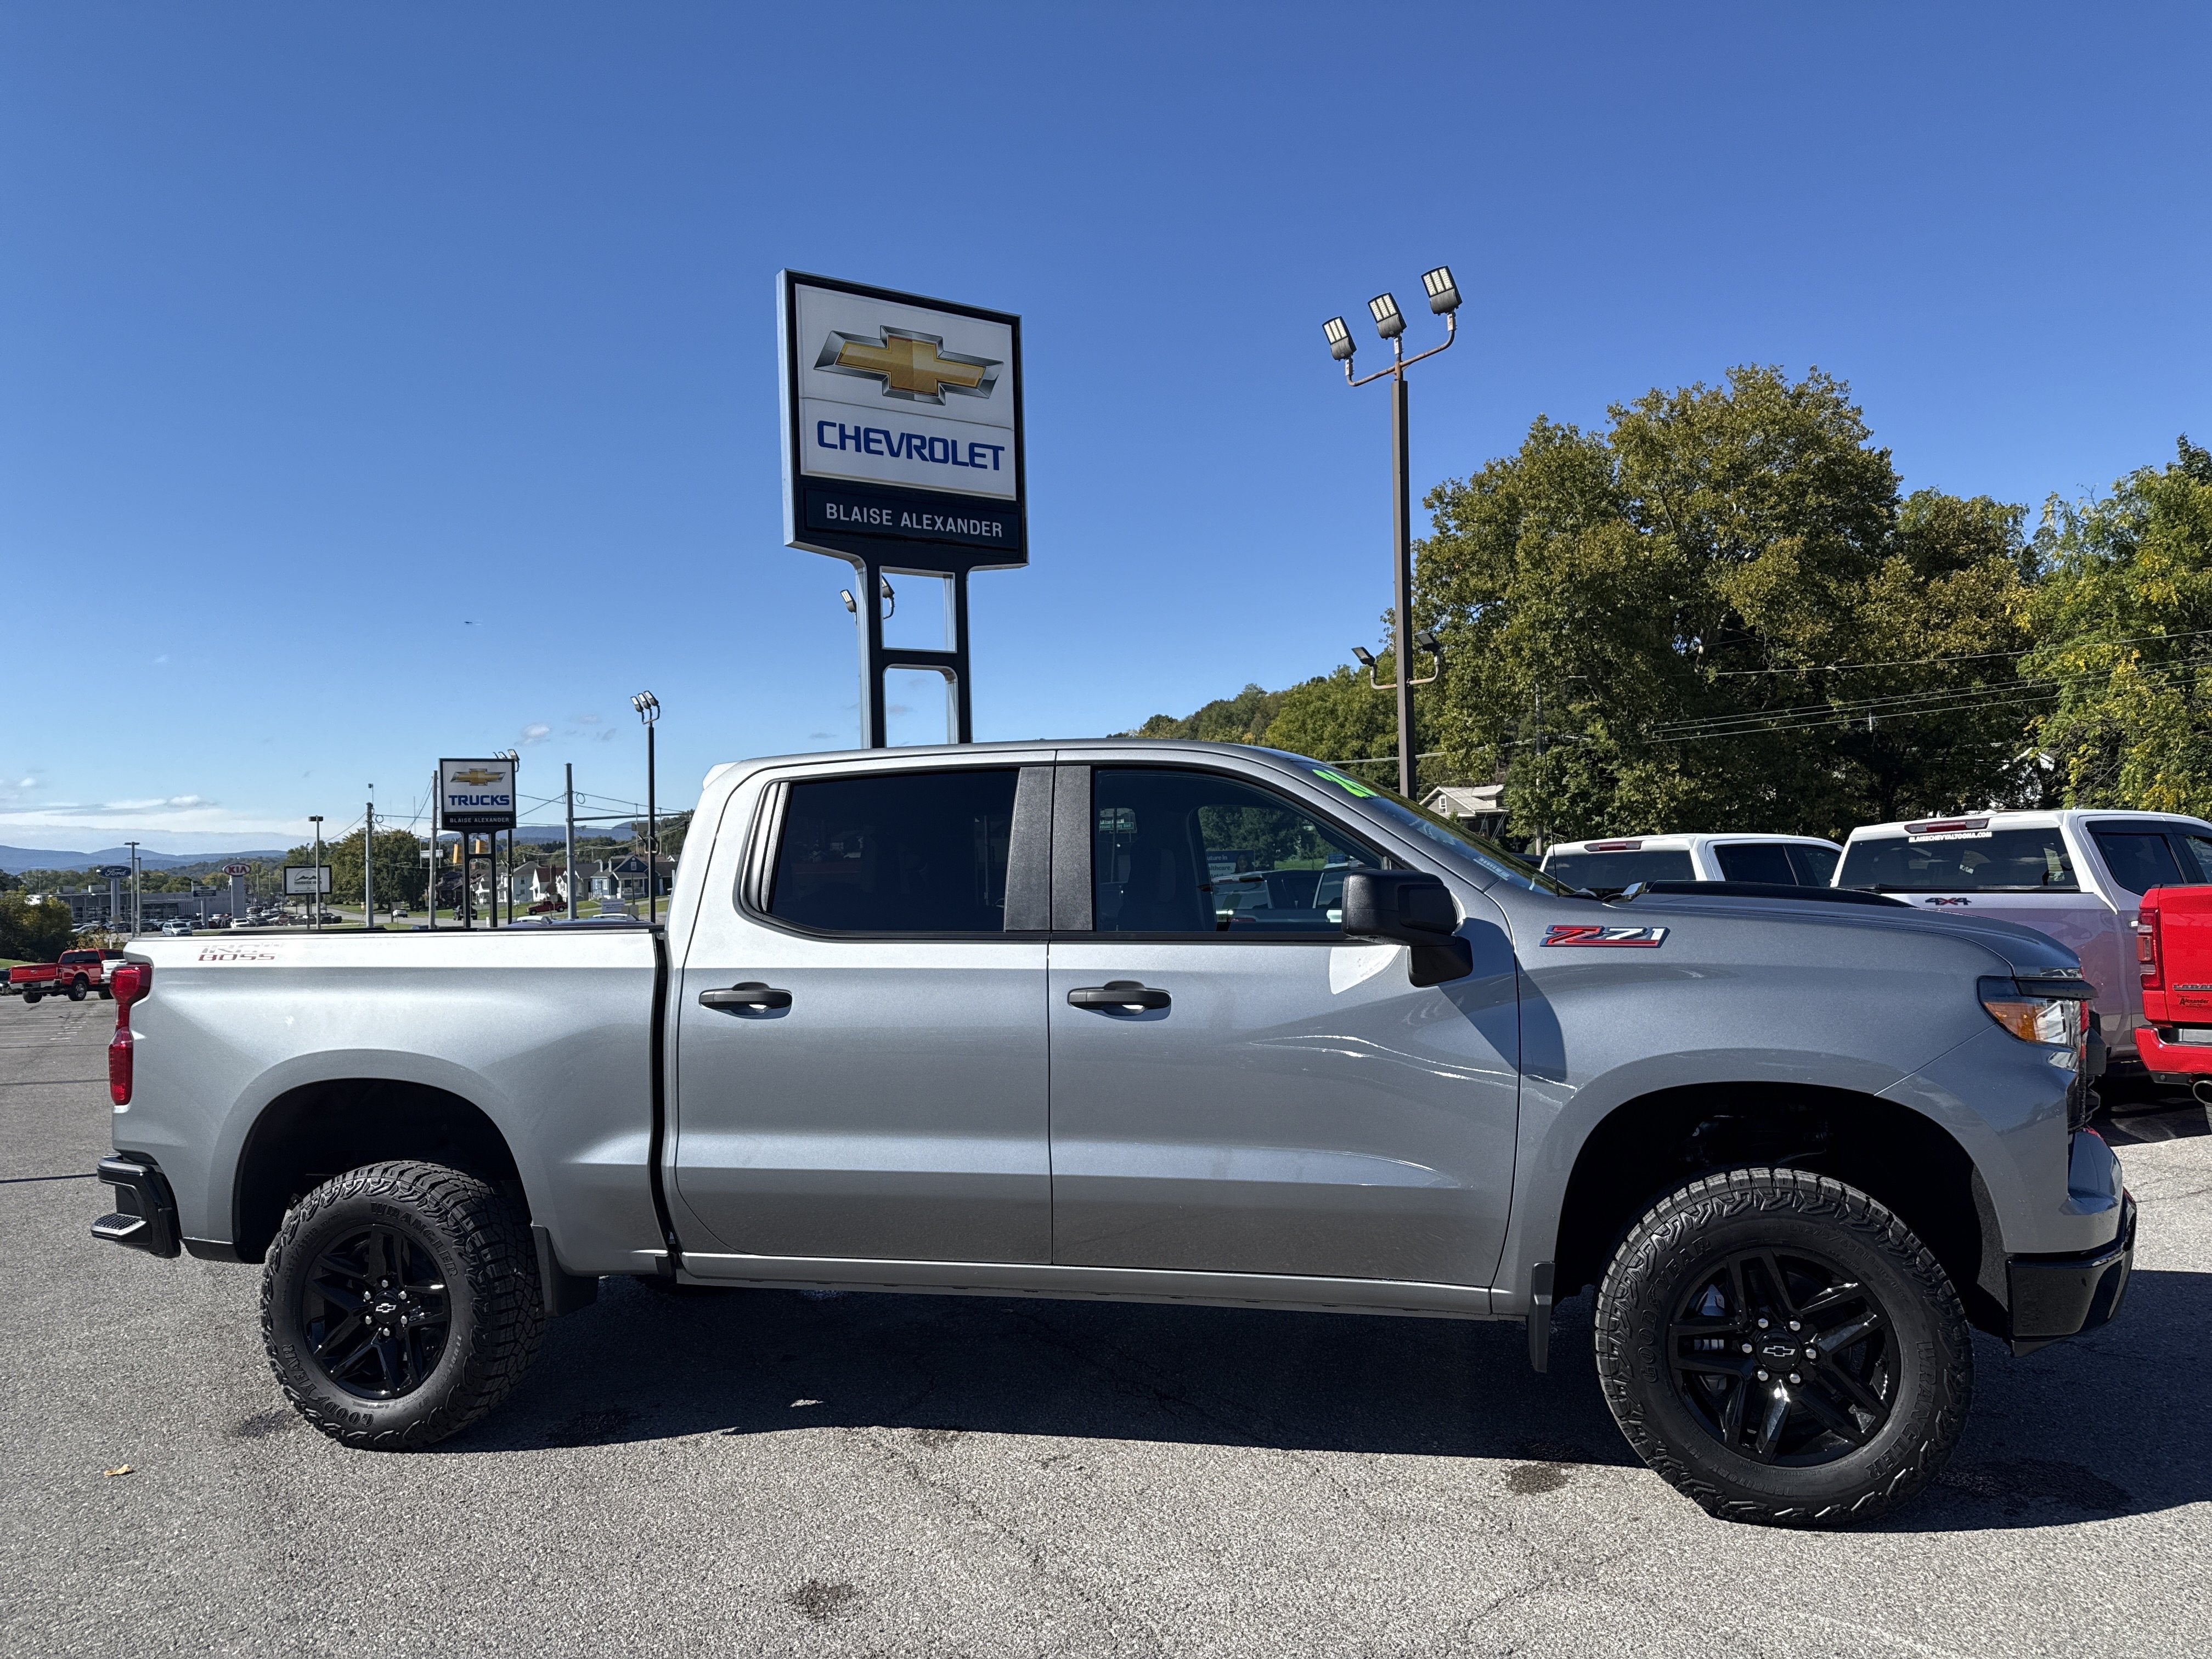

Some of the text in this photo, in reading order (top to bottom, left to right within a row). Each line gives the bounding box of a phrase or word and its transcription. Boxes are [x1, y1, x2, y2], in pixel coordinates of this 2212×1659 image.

[817, 420, 1005, 471] CHEVROLET
[826, 503, 1002, 538] BLAISE ALEXANDER
[448, 794, 510, 806] TRUCKS
[1909, 832, 1992, 843] BLAISECHEVYALTOONA.COM
[105, 868, 127, 876] Ford
[1539, 925, 1671, 948] Z71
[198, 953, 276, 961] BOSS
[370, 1201, 459, 1277] WRANGLER
[1638, 1236, 1712, 1383] GOODYEAR
[281, 1343, 374, 1427] GOODYEAR
[1864, 1341, 1936, 1481] WRANGLER
